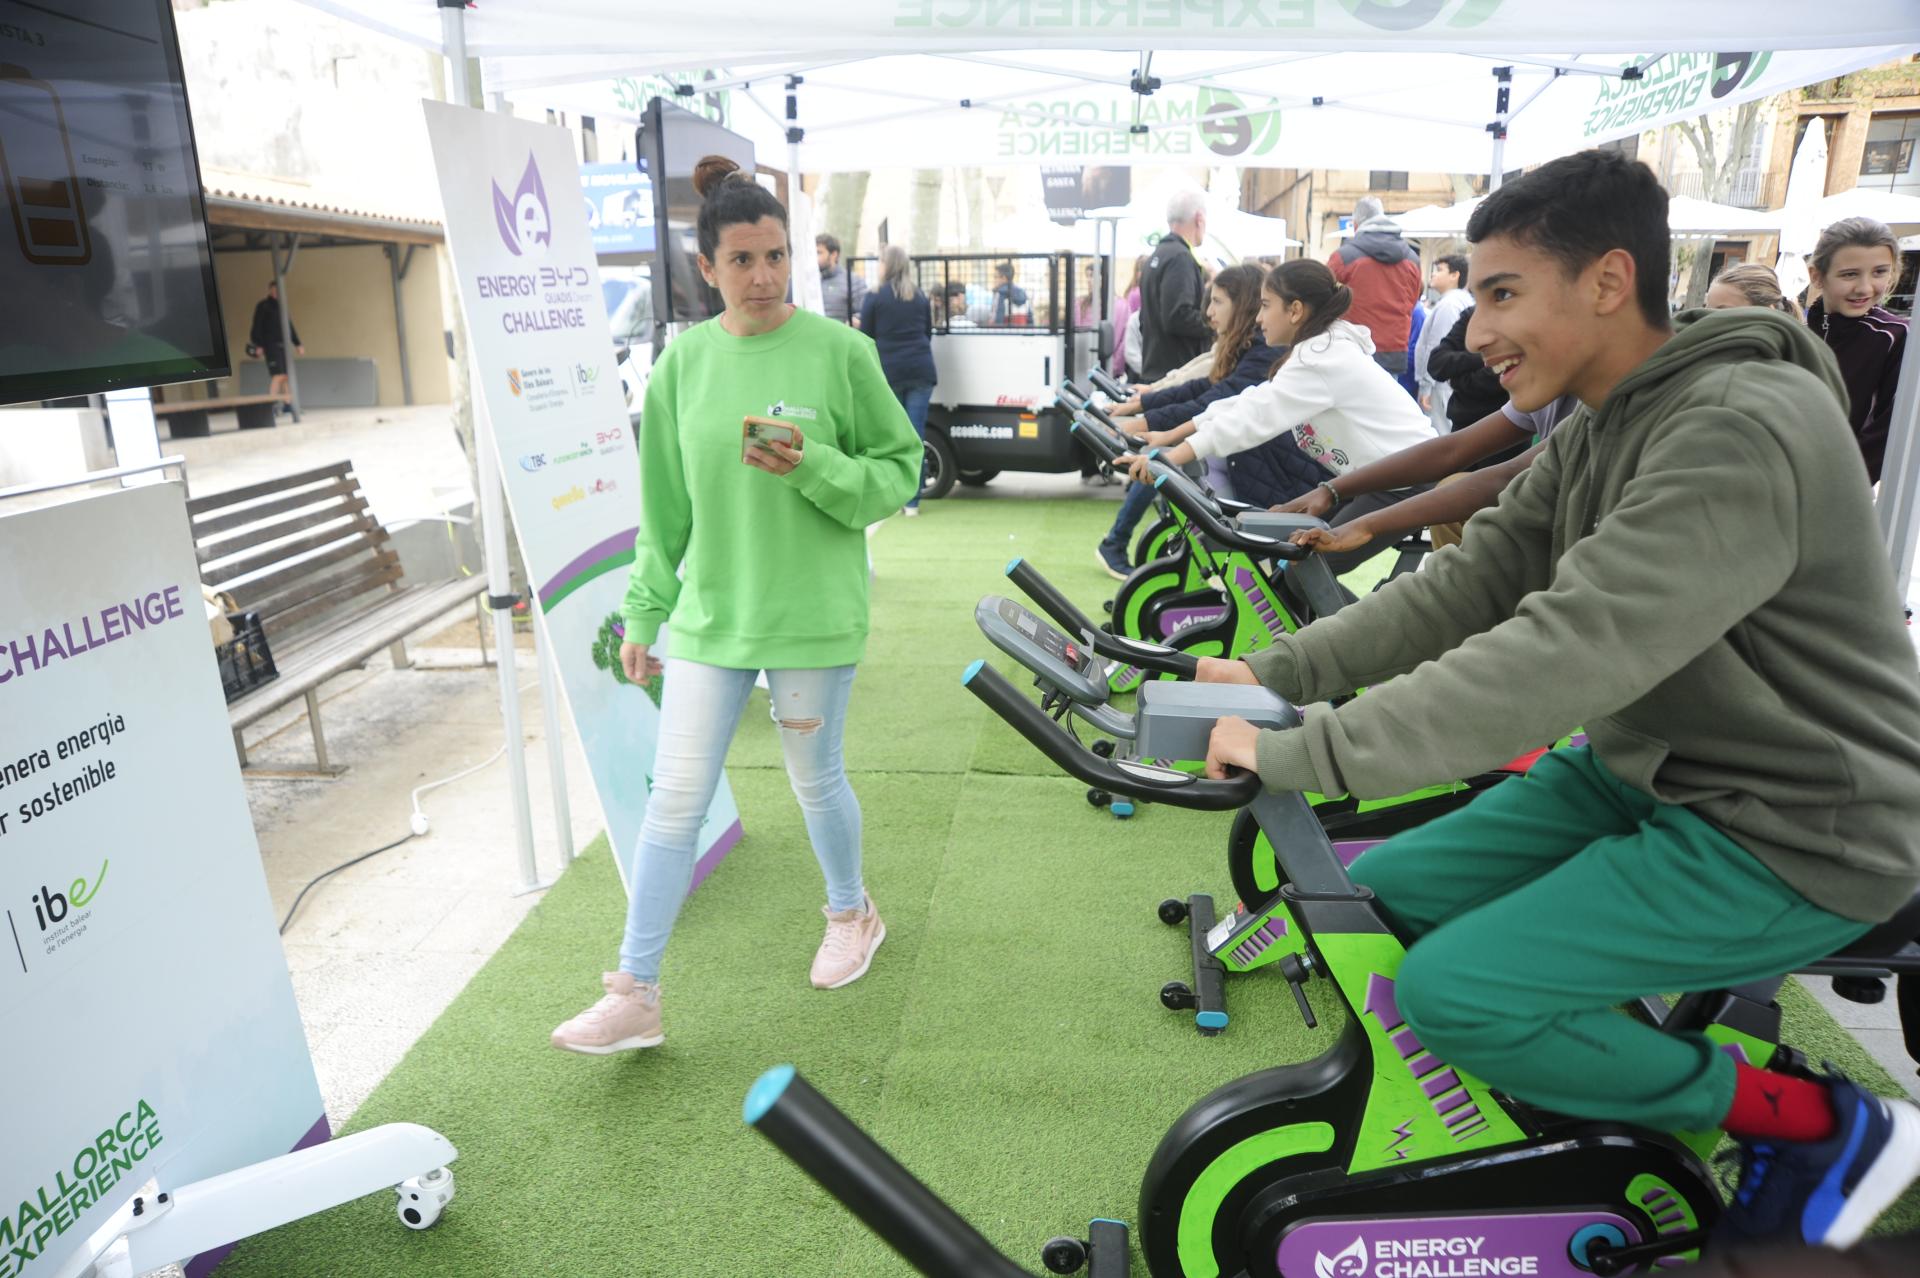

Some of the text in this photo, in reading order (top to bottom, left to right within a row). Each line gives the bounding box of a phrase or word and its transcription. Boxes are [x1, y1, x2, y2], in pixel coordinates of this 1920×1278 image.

[476, 274, 537, 299] ENERGY
[502, 307, 586, 335] CHALLENGE
[57, 712, 126, 760] energia
[19, 759, 116, 824] sostenible
[32, 859, 109, 932] ibe
[43, 910, 92, 945] institut balear
[45, 944, 57, 955] de
[0, 1098, 157, 1248] MALLORCA
[1374, 1236, 1486, 1259] ENERGY
[1374, 1256, 1539, 1278] CHALLENGE
